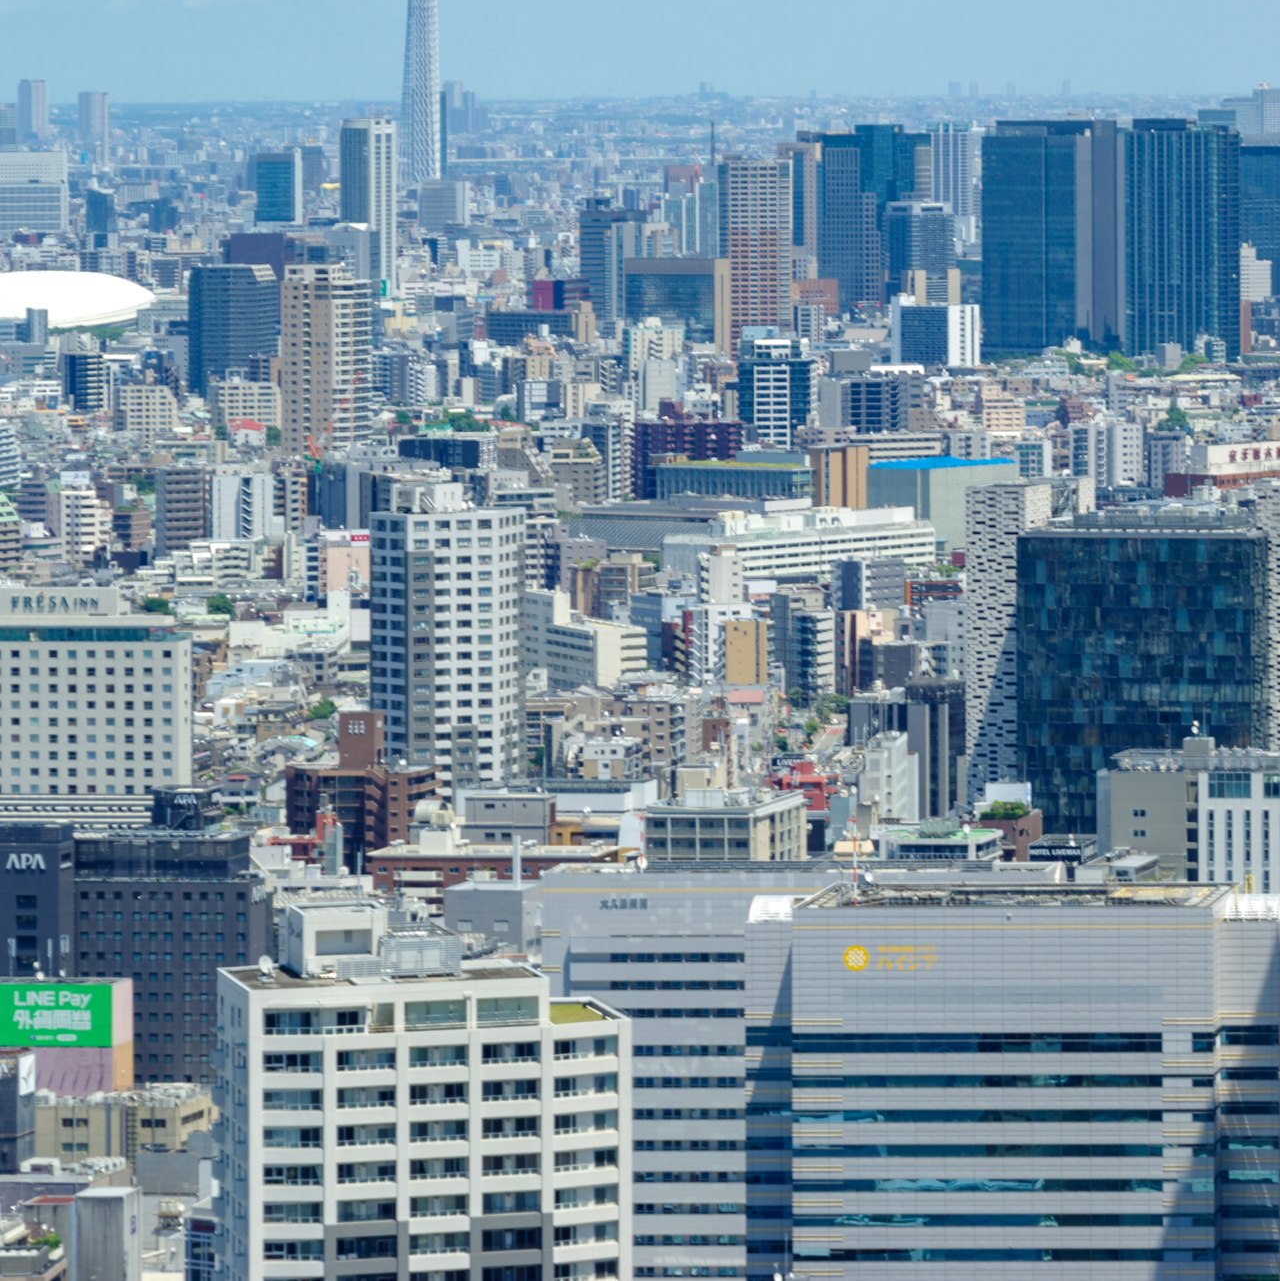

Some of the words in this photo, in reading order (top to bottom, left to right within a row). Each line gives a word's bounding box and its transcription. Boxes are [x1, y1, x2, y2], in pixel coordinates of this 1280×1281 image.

[74, 597, 99, 608] INN
[174, 794, 197, 805] APA
[1029, 848, 1051, 856] HOTEL
[1051, 848, 1081, 856] LIVEMAX
[6, 853, 46, 870] APA
[13, 990, 56, 1006] LINE
[58, 990, 92, 1008] Pay
